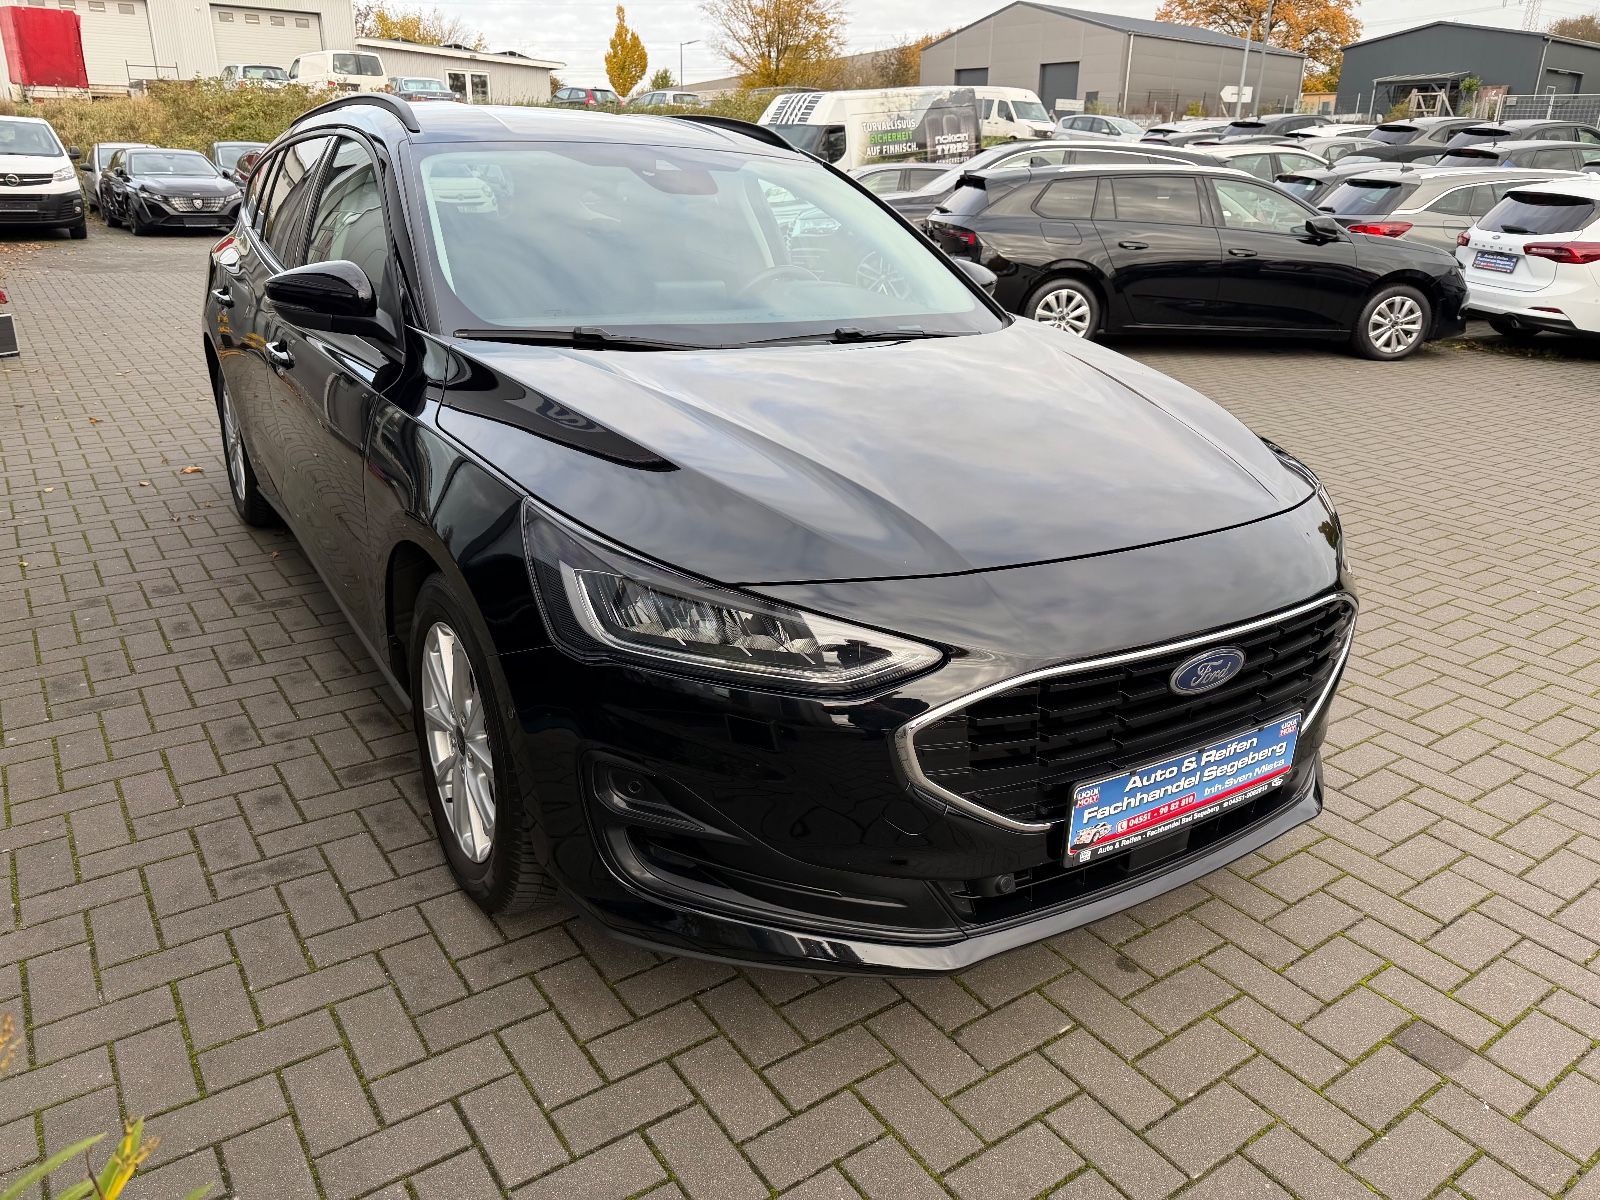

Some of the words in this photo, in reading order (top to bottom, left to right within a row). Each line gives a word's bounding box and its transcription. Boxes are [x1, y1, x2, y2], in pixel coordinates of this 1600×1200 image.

[862, 119, 918, 132] TURVALLISUUS.
[870, 131, 913, 144] SICHERHEIT
[866, 146, 880, 158] AUF
[882, 142, 919, 155] FINNISCH.
[935, 142, 970, 156] TYRES
[1190, 659, 1232, 687] Ford
[1123, 766, 1178, 793] Auto
[1181, 756, 1198, 773] &
[1200, 737, 1258, 766] Reifen
[1082, 771, 1201, 825] Fachhandel
[1202, 741, 1287, 782] Segeberg
[1076, 794, 1100, 808] MOLY
[1128, 812, 1152, 827] 04551
[1097, 844, 1114, 855] Auto
[1120, 835, 1142, 847] Reifen
[1146, 819, 1181, 838] Fachhandel
[1181, 815, 1193, 825] Bad
[1193, 805, 1220, 820] Segeberg
